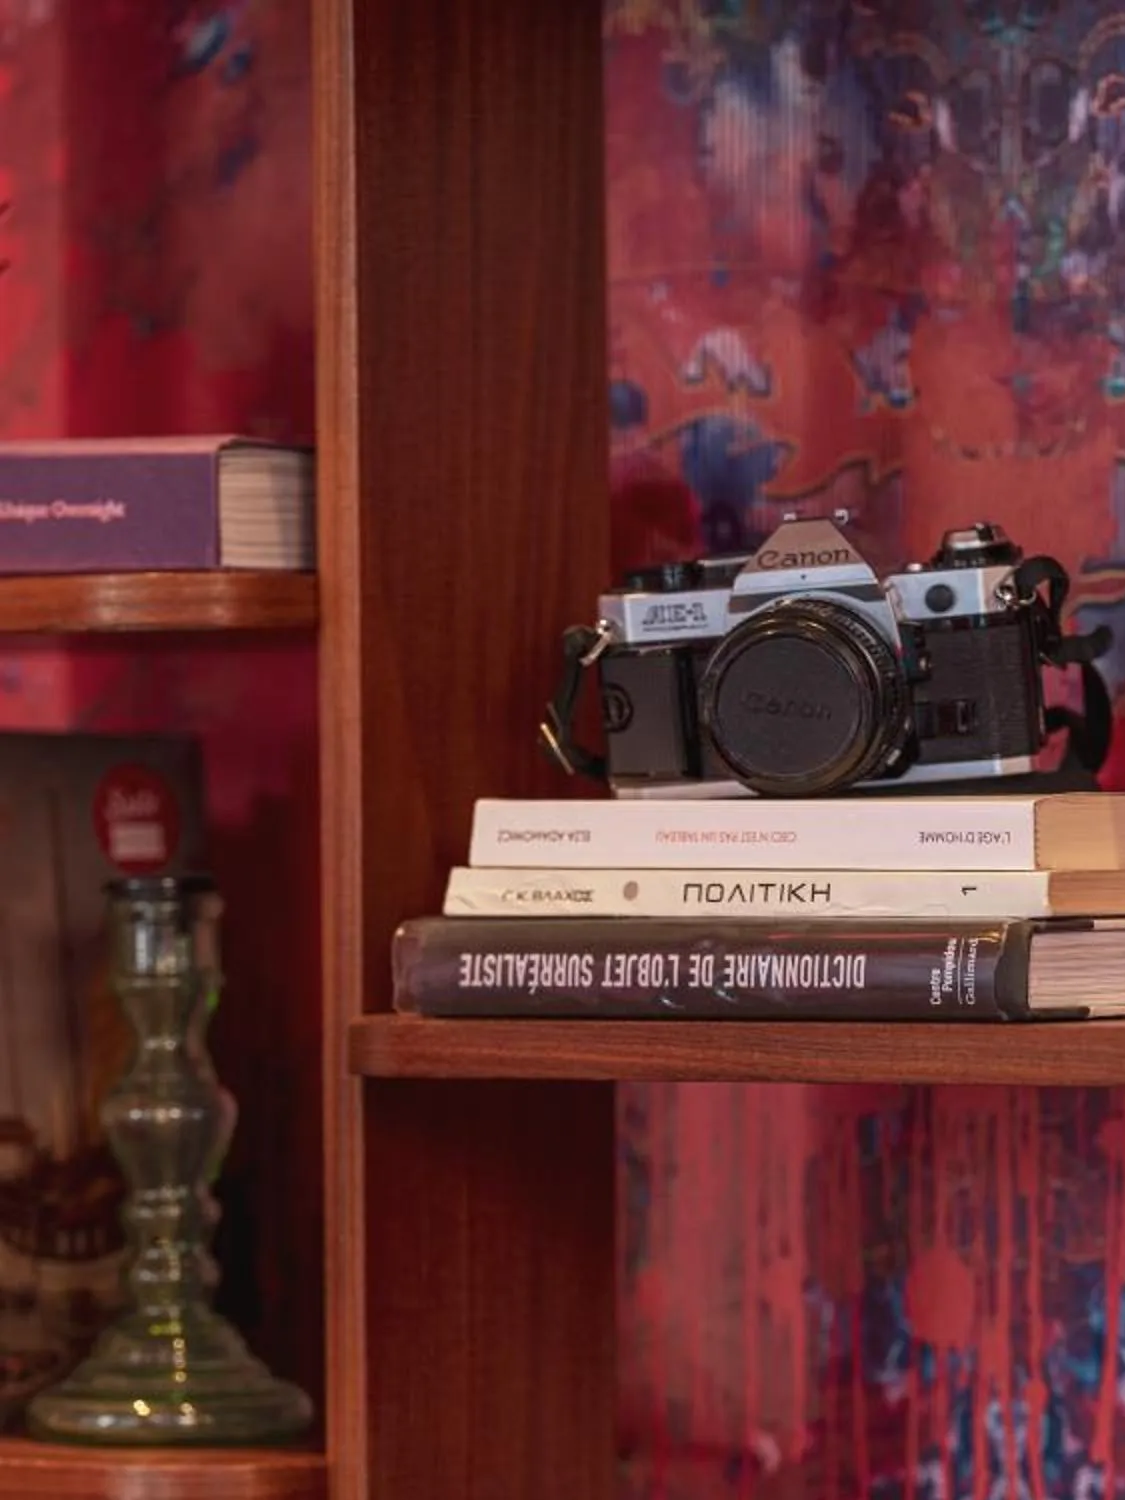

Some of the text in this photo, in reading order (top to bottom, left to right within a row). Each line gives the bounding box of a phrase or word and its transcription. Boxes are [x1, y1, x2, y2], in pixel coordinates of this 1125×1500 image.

[757, 549, 849, 570] Canon
[743, 692, 832, 722] Canon
[683, 883, 832, 903] ΠΟΛΙΤΙΚΗ
[458, 952, 867, 995] DICTIONNAIRE DE L'OBJET SURRÉALISTE
[964, 937, 979, 1006] Gallimard
